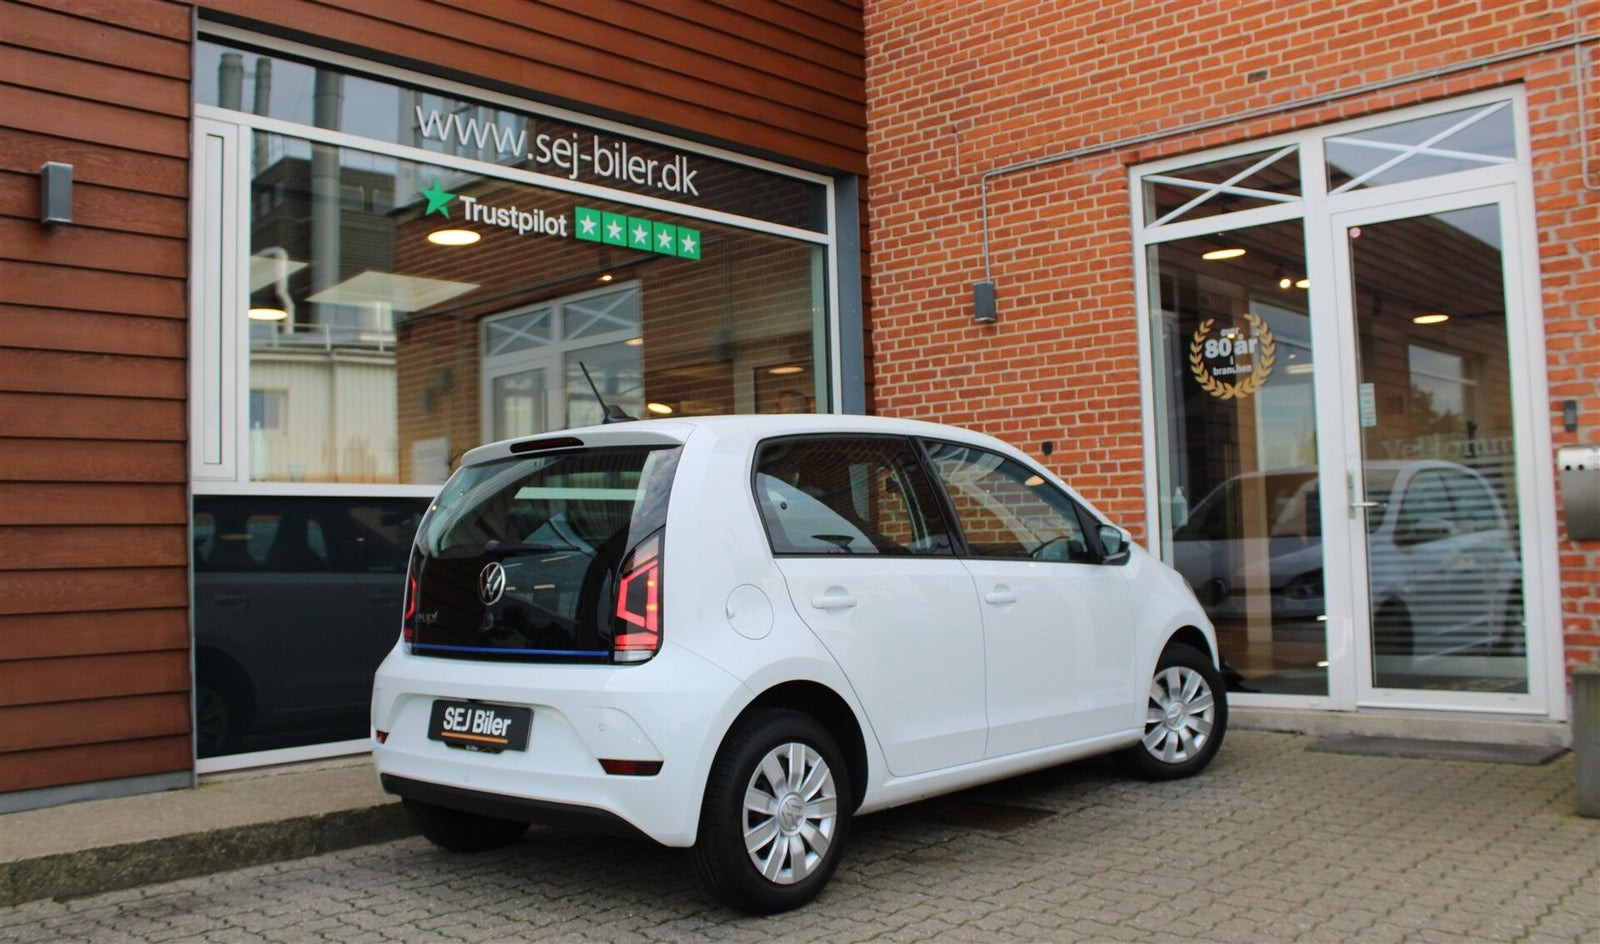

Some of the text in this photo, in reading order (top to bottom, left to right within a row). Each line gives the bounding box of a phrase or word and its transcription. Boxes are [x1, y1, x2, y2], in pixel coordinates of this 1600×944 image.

[416, 105, 699, 196] www.sej-biler.dk
[459, 195, 568, 237] Trustpilot
[1204, 333, 1258, 359] 80 år
[443, 706, 512, 736] SEJ Biler
